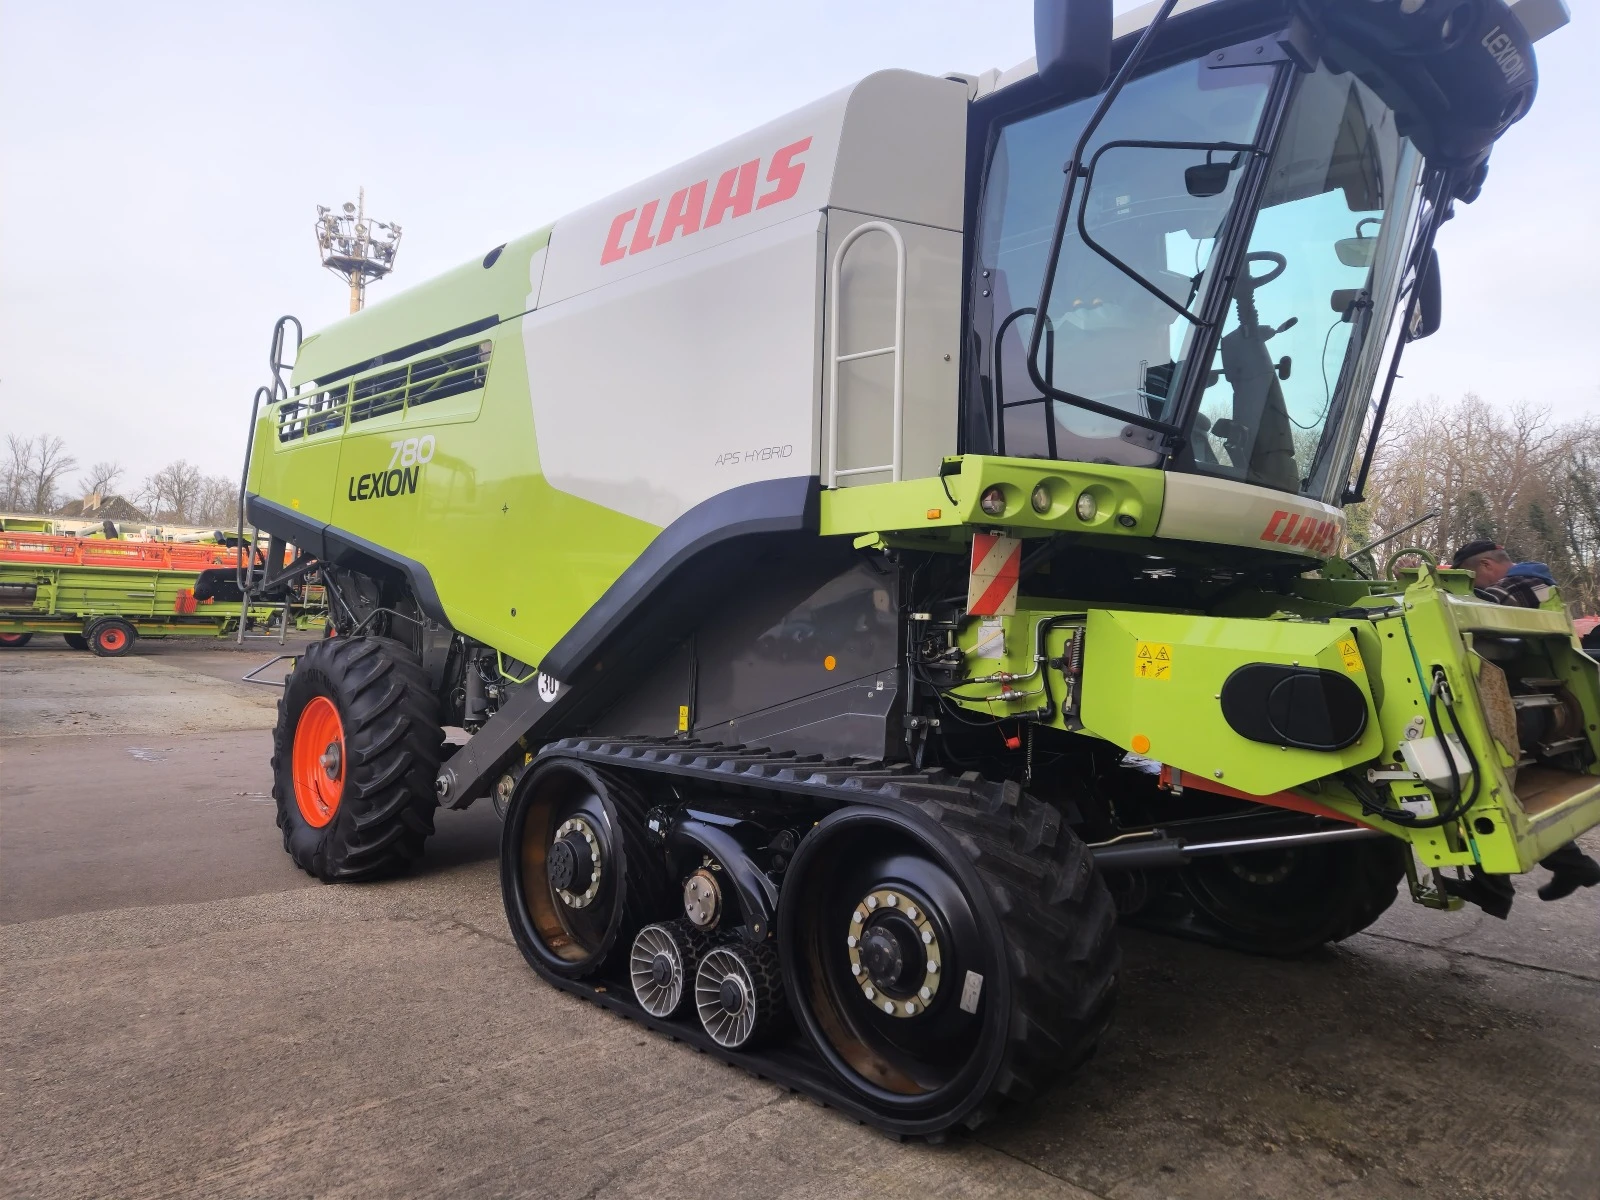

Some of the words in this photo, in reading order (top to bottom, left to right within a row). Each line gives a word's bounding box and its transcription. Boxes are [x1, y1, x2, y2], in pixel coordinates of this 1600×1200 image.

[1481, 25, 1526, 84] LEXION
[600, 135, 813, 266] CLAAS
[387, 434, 436, 470] 780
[714, 451, 741, 466] APS
[744, 444, 793, 462] HYBRID
[348, 465, 420, 502] LEXION
[1260, 510, 1337, 554] CLAAS
[541, 673, 556, 695] 30
